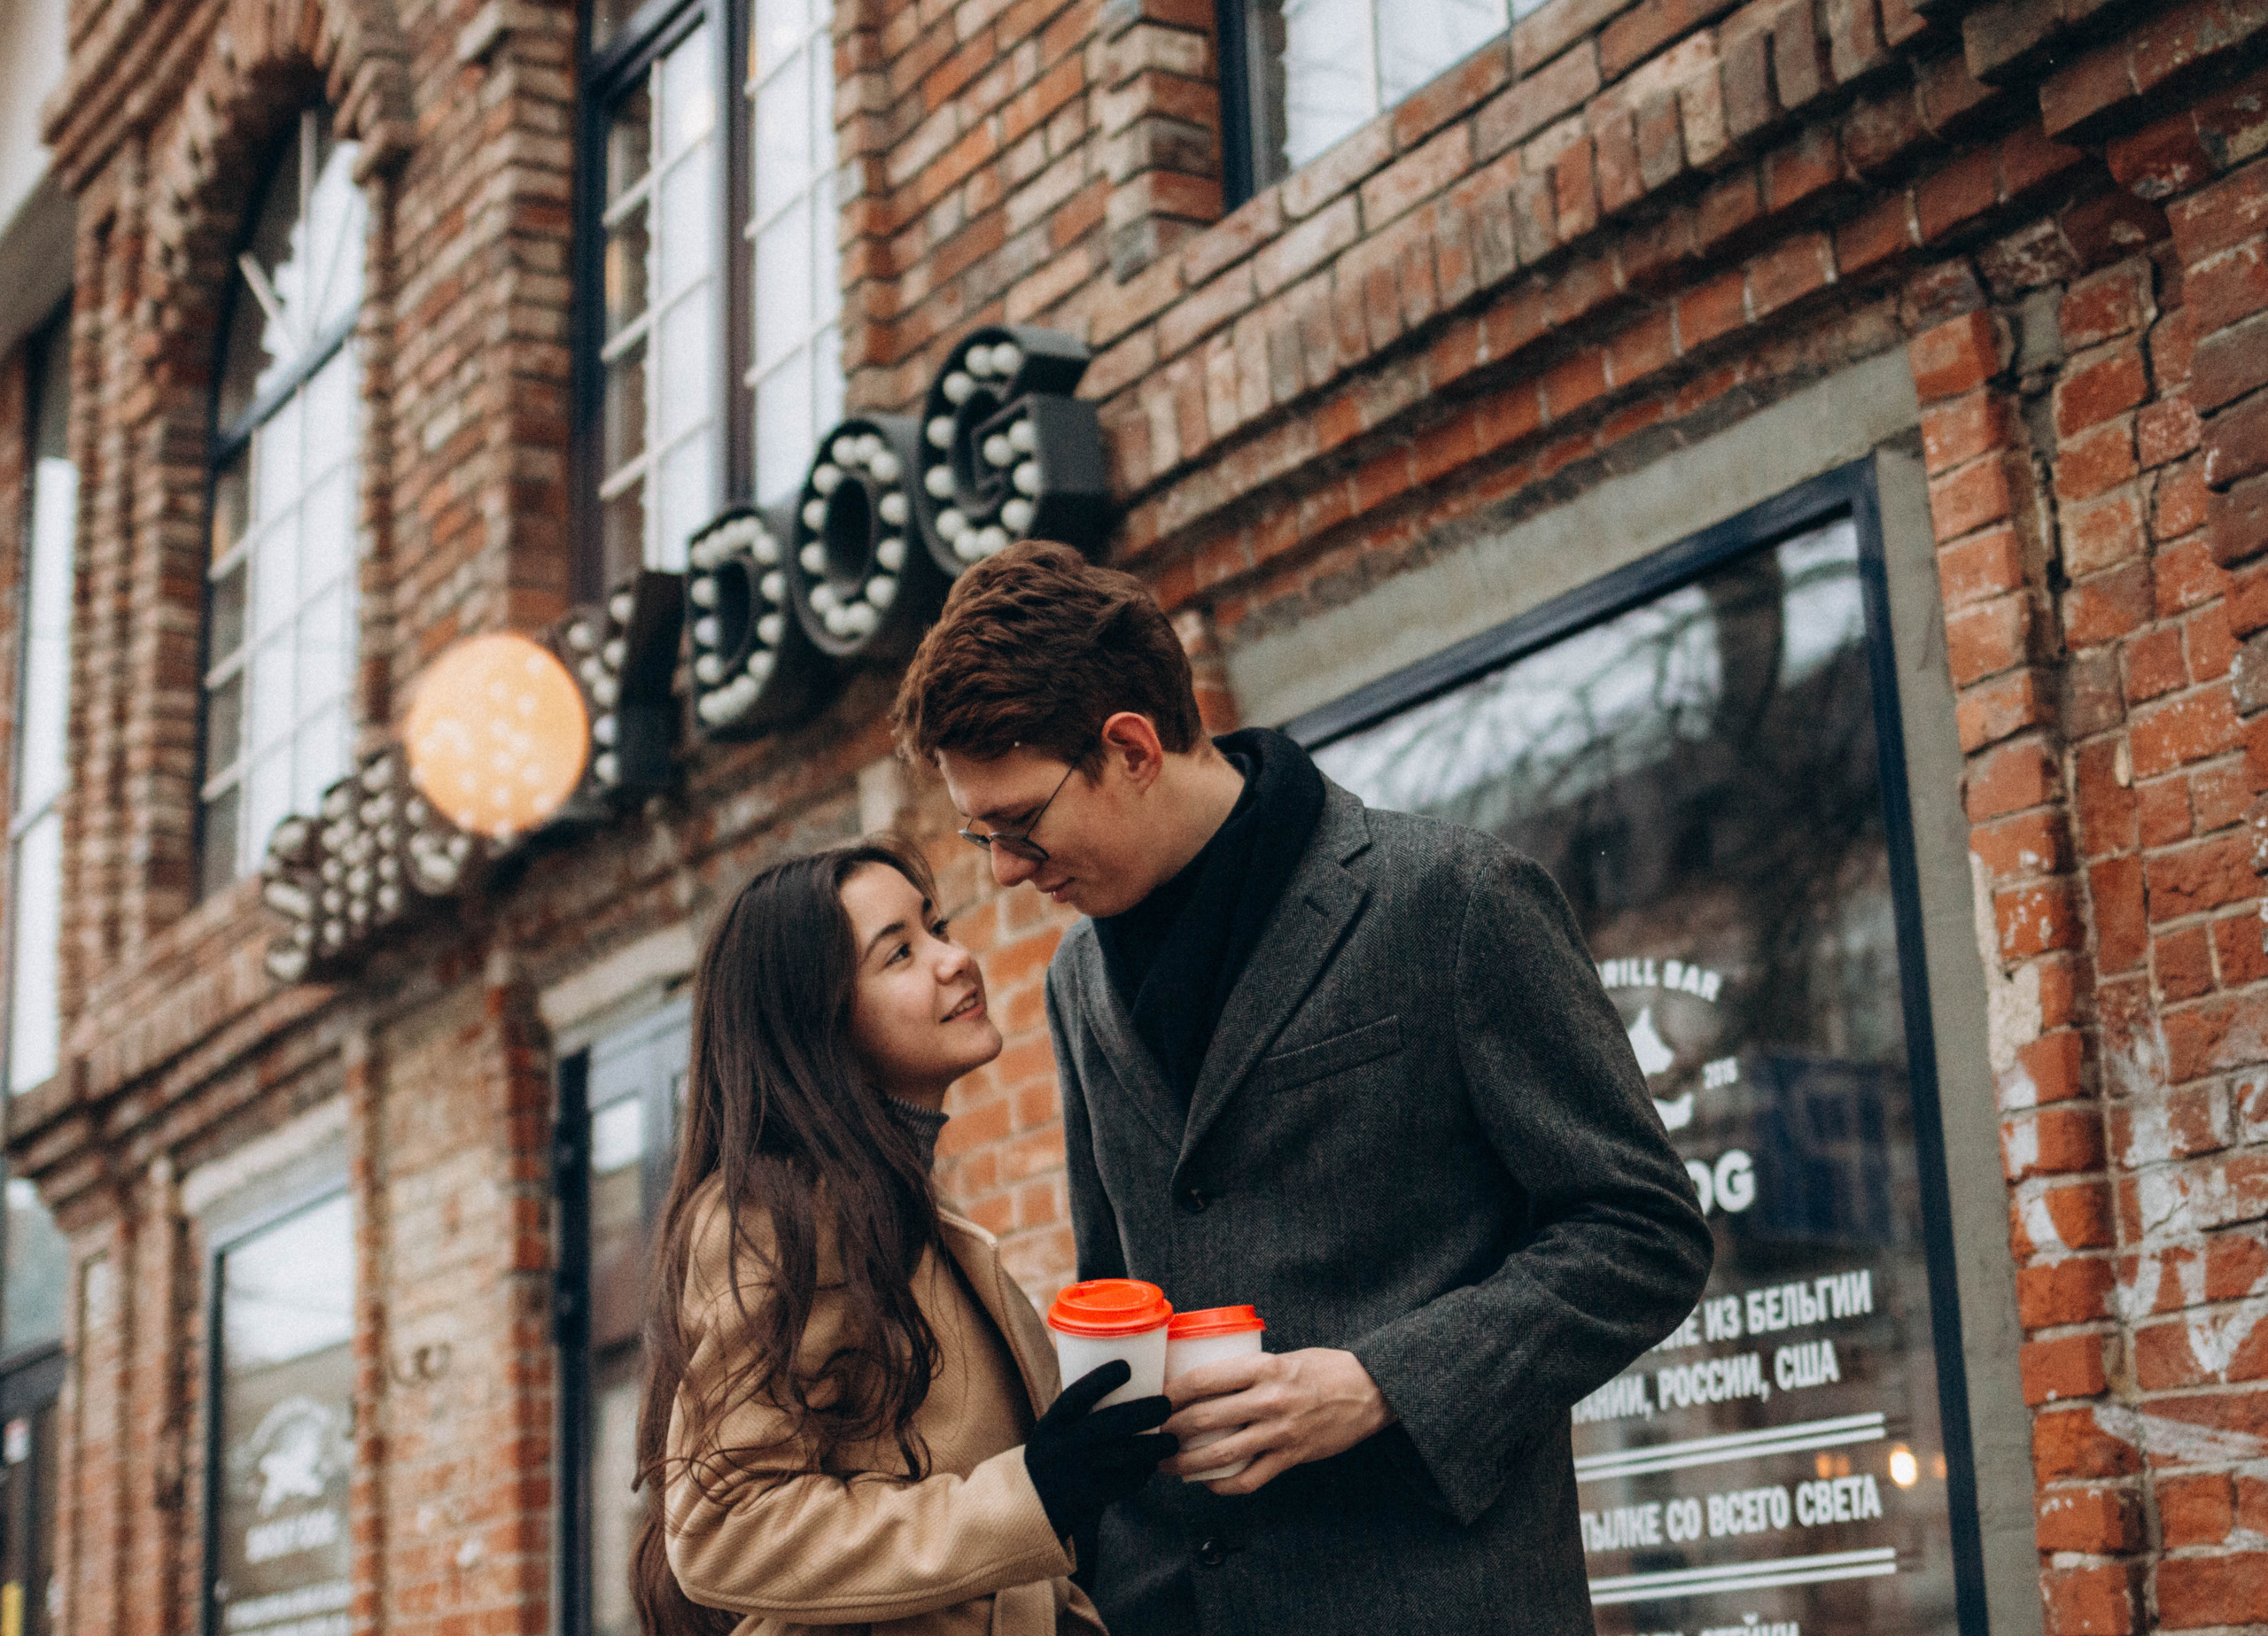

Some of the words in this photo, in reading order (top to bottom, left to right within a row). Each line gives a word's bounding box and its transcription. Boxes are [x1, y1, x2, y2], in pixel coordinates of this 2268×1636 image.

[687, 326, 1068, 731] DOG
[1596, 958, 1657, 989] RILL
[1665, 959, 1720, 1003] BAR
[1683, 1149, 1757, 1214] OG
[1704, 1294, 1742, 1343] ИЗ
[1745, 1268, 1873, 1335] БЕЛЬГИИ
[1571, 1374, 1653, 1424] АНИИ,
[1658, 1352, 1770, 1411] РОССИИ,
[1775, 1338, 1839, 1392] США
[1581, 1500, 1662, 1552] ТЫЛКЕ
[1666, 1497, 1702, 1543] СО
[1707, 1485, 1790, 1538] ВСЕГО
[1796, 1473, 1883, 1527] СВЕТА
